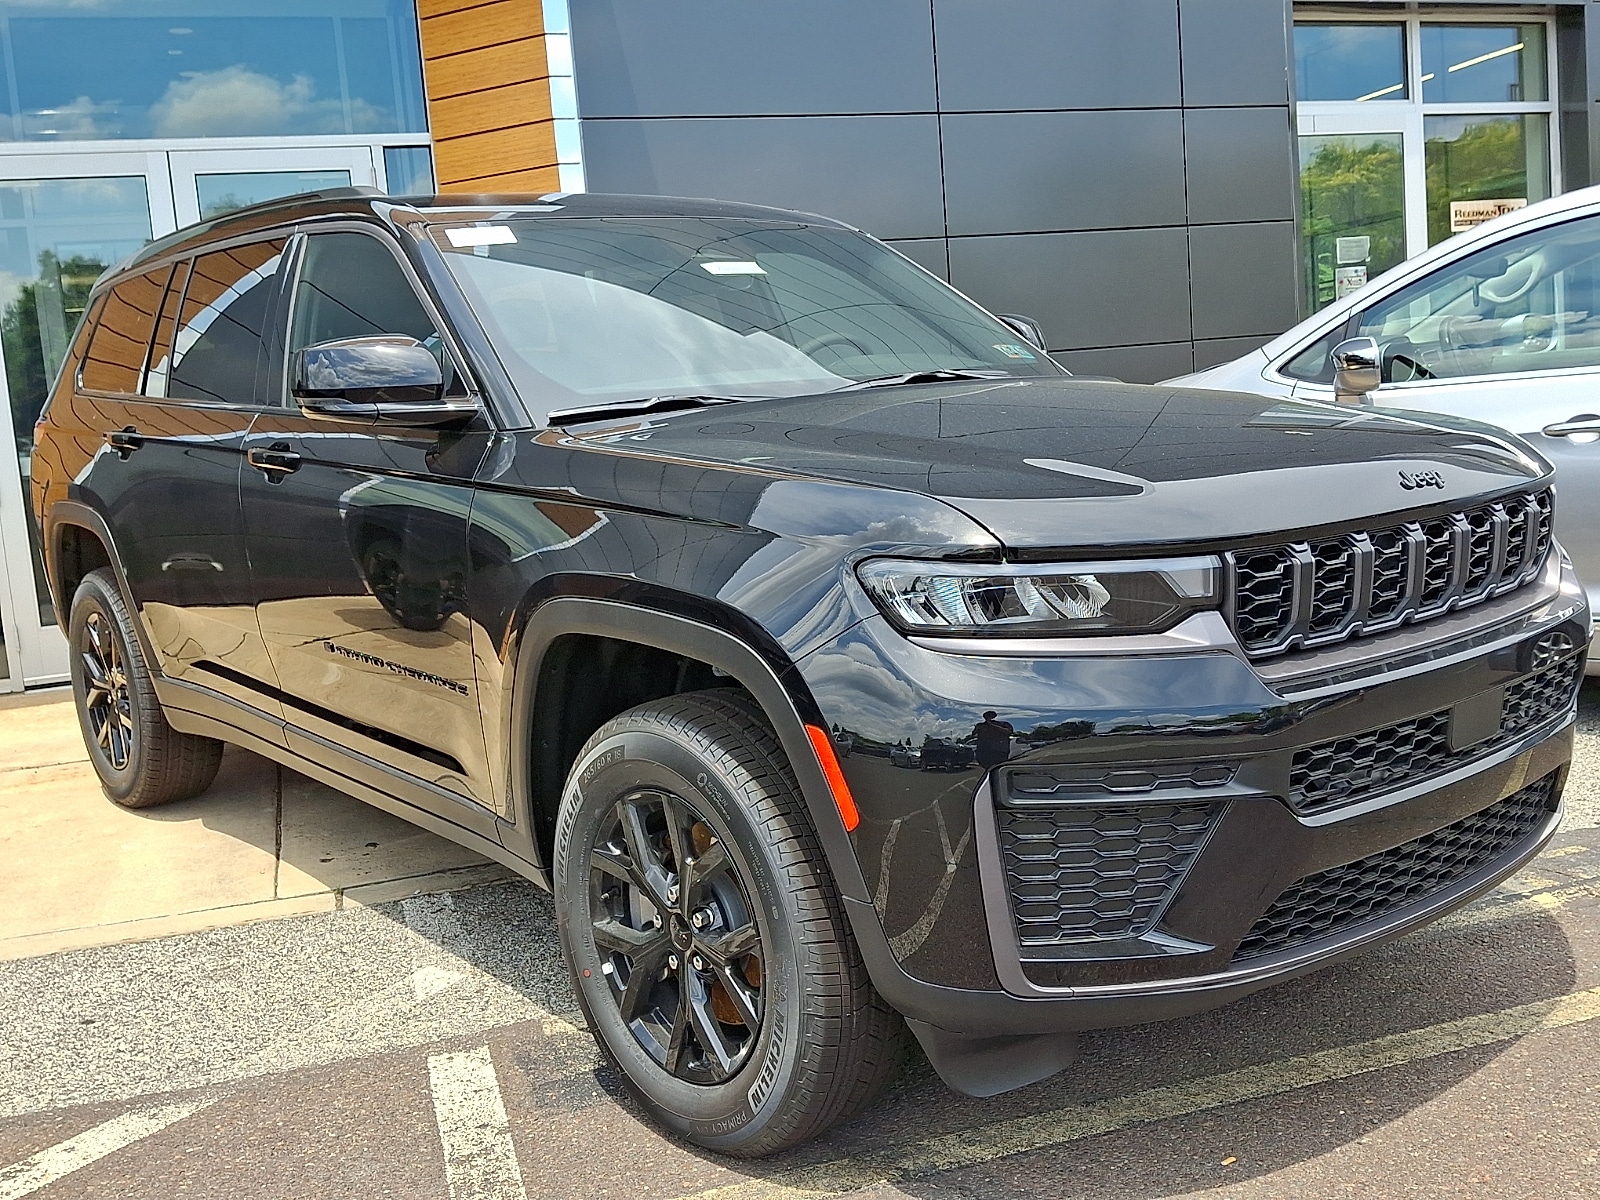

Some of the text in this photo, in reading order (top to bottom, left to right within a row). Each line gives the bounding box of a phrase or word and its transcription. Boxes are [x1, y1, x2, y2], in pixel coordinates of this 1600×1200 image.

[1398, 470, 1445, 490] Jeep
[606, 753, 612, 763] R
[558, 788, 581, 880] MICHELIN
[751, 1009, 785, 1109] MICHELIN
[712, 1110, 747, 1133] PRIMACY
